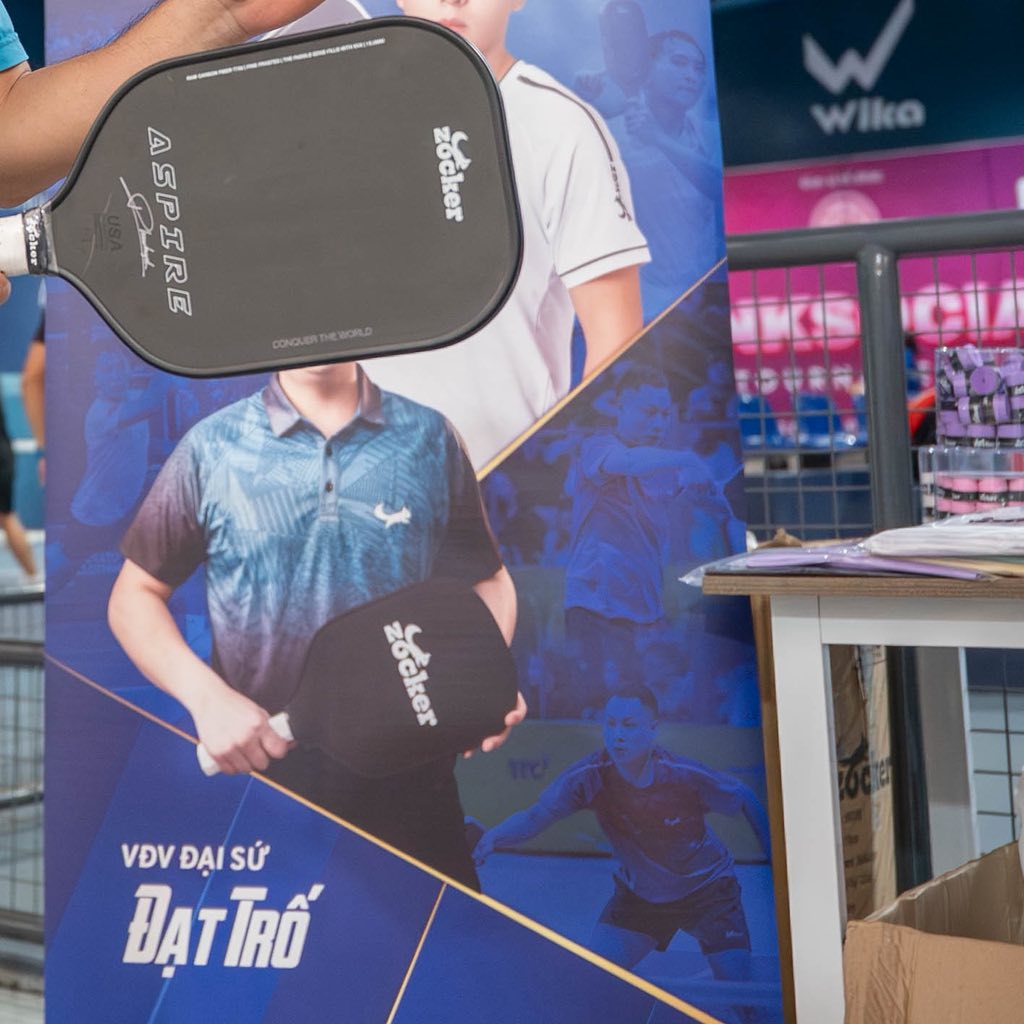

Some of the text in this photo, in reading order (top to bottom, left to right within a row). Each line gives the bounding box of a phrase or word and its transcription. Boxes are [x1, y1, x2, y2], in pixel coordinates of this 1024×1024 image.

[147, 126, 193, 317] ASPIRE
[433, 125, 466, 223] zocker
[383, 620, 438, 727] zocker
[121, 843, 175, 868] VĐV
[179, 844, 225, 877] ĐẠI
